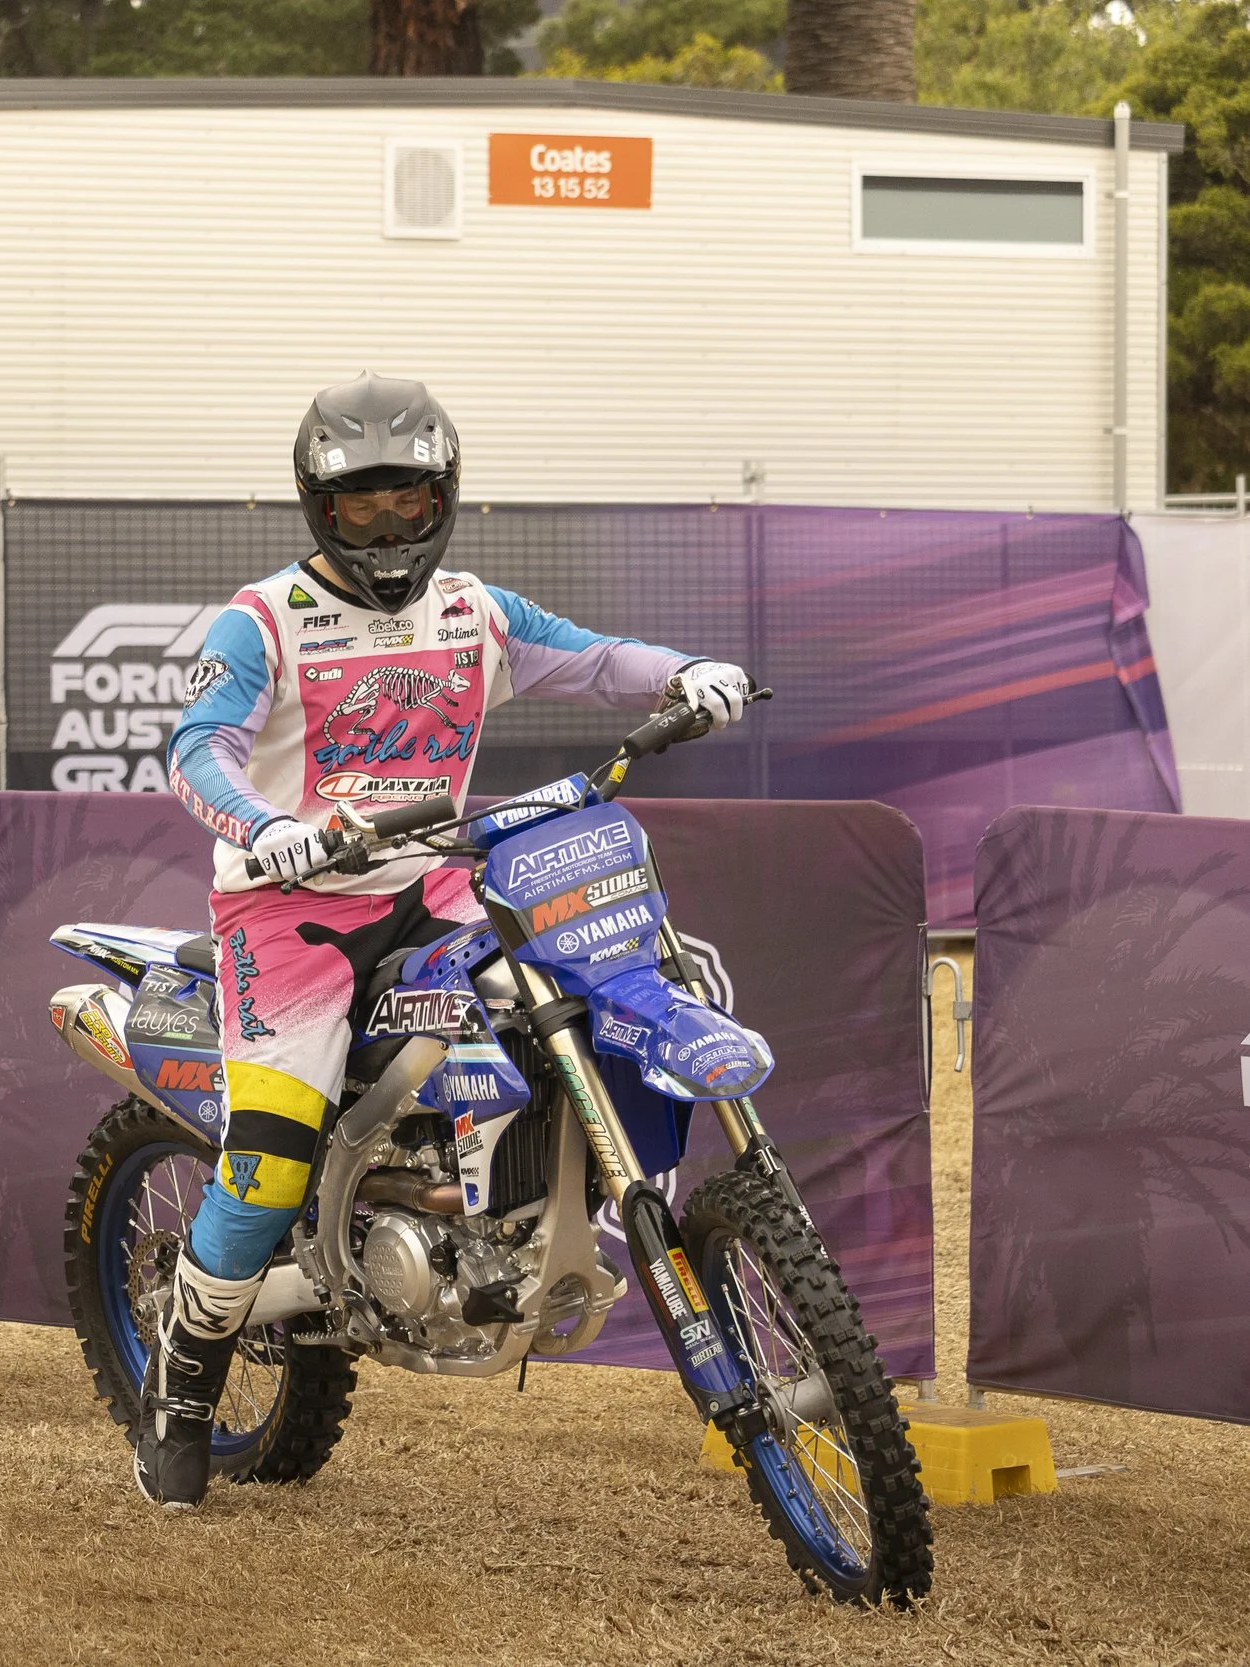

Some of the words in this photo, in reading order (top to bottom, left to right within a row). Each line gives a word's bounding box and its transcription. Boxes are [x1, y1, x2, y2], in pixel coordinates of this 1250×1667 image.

[530, 144, 612, 174] Coates
[532, 176, 555, 198] 13
[558, 177, 581, 198] 15
[583, 178, 610, 199] 52
[303, 613, 342, 629] FIST
[372, 793, 424, 803] RACING
[508, 821, 631, 890] AIRTIME
[524, 852, 632, 900] AIRTIMEFMX.COM
[576, 905, 653, 945] YAMAHA
[590, 939, 629, 965] KMX
[145, 980, 178, 993] FIST
[90, 1009, 113, 1039] PRO
[131, 1004, 200, 1036] lauxes
[79, 1012, 124, 1064] CIRCUIT
[688, 1032, 740, 1051] YAMAHA
[449, 1074, 500, 1101] YAMAHA
[455, 1112, 475, 1139] MX
[458, 1130, 483, 1153] STORE
[81, 1153, 114, 1244] PIRELLI
[649, 1257, 687, 1320] YAMALUBE
[672, 1252, 707, 1308] PIRELLI
